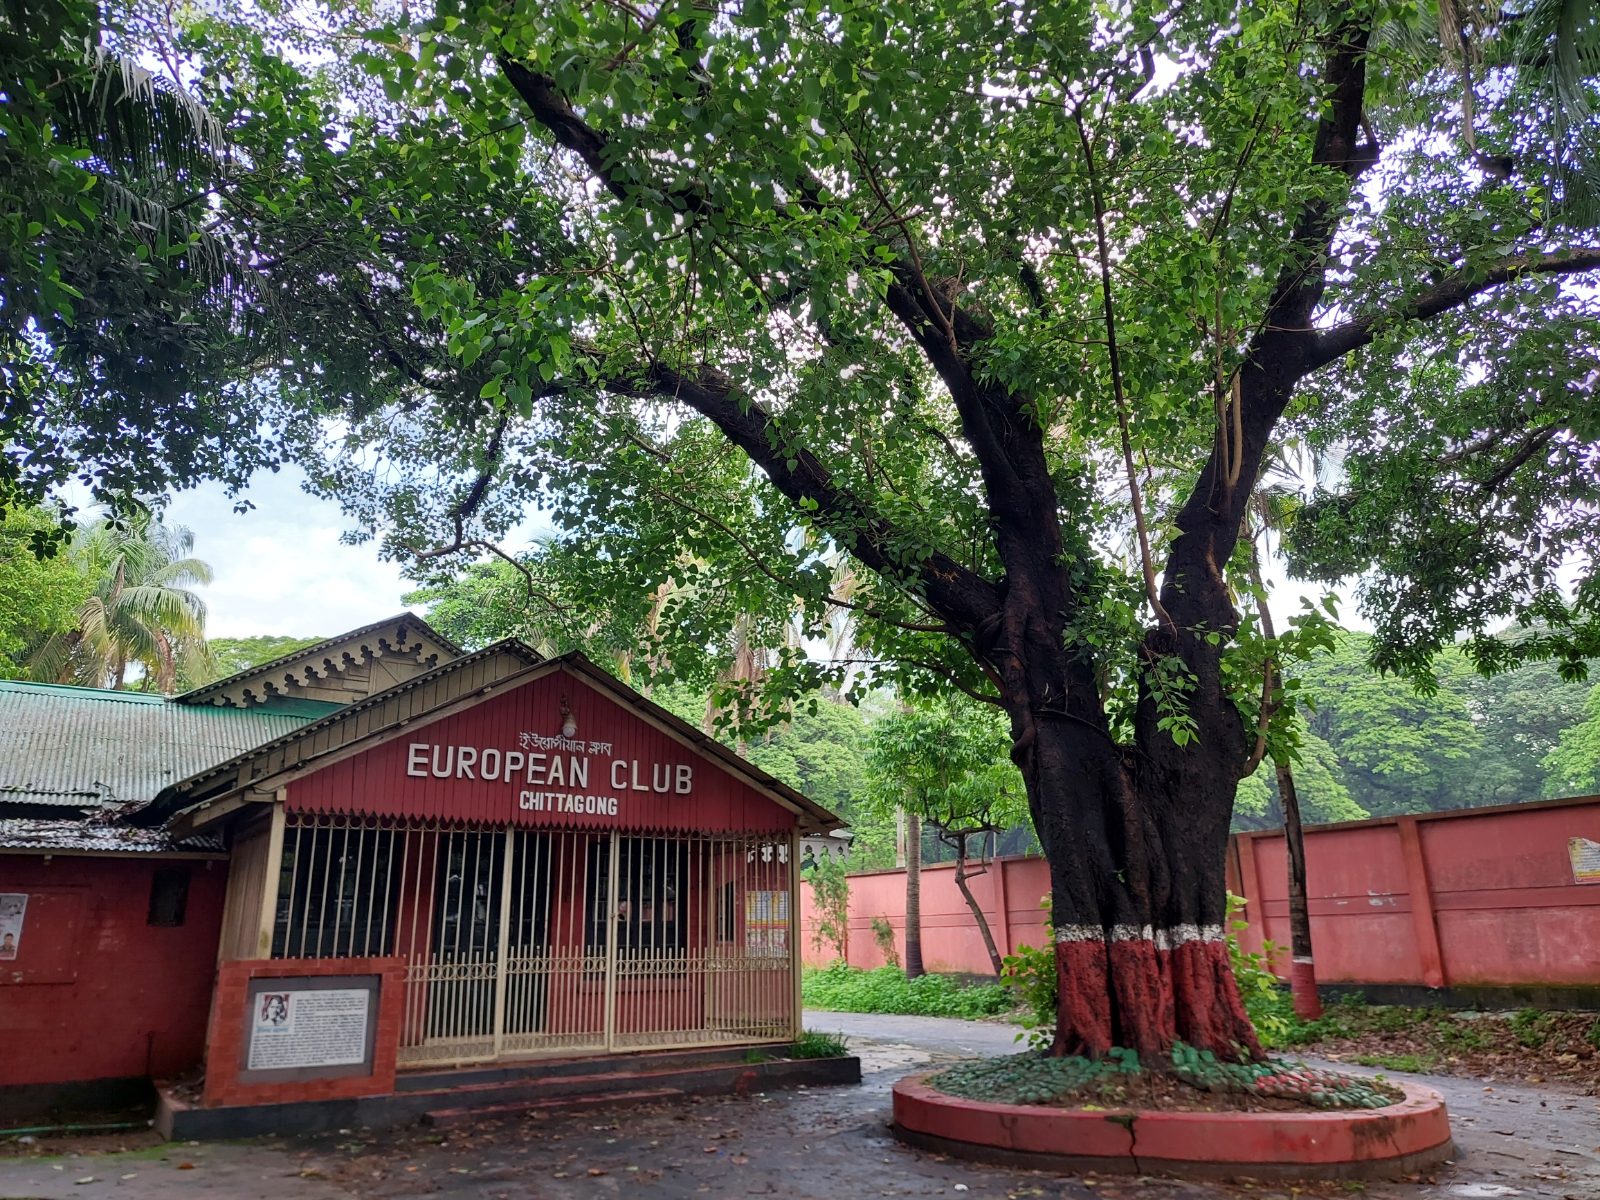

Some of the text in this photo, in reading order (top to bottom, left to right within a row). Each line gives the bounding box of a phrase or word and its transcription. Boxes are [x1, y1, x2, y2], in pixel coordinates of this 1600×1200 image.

[407, 742, 693, 795] EUROPEAN CLUB
[519, 790, 618, 816] CHITTAGONG
